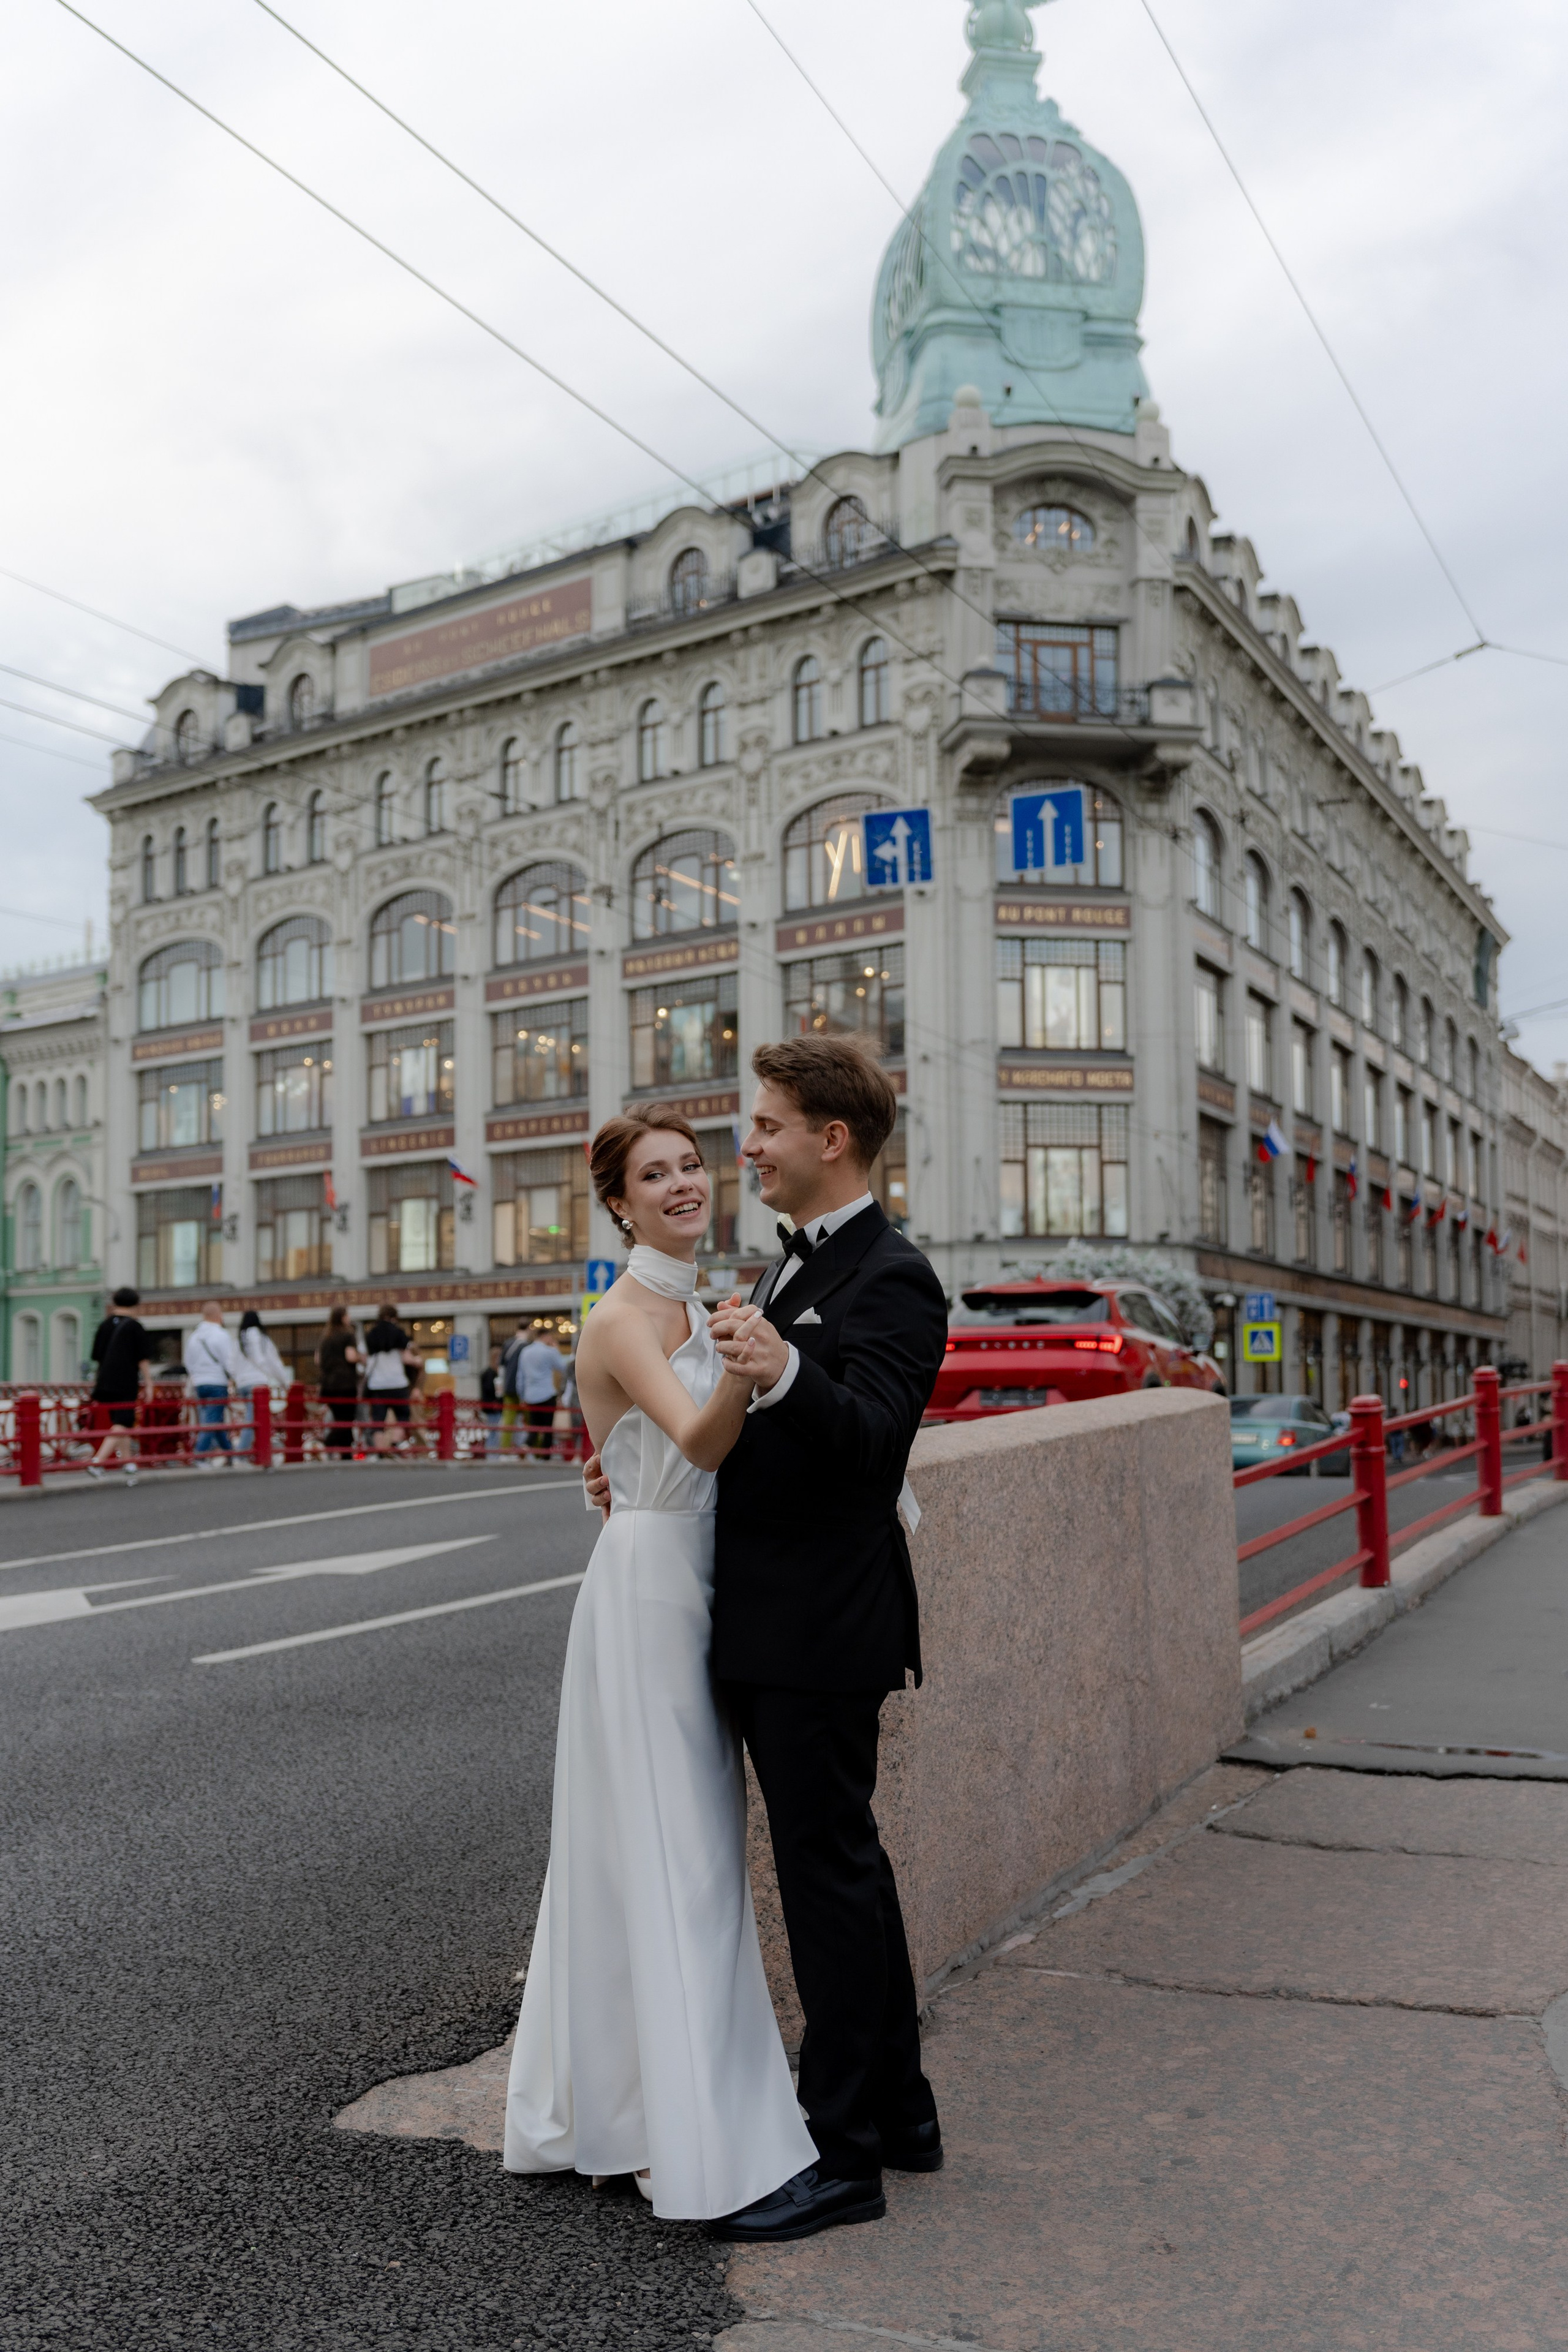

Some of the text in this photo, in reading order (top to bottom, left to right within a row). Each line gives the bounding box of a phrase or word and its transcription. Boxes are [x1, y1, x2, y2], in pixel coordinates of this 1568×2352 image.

[998, 905, 1126, 925] AU PONT ROUGE
[503, 972, 573, 996] ОБУВЬ
